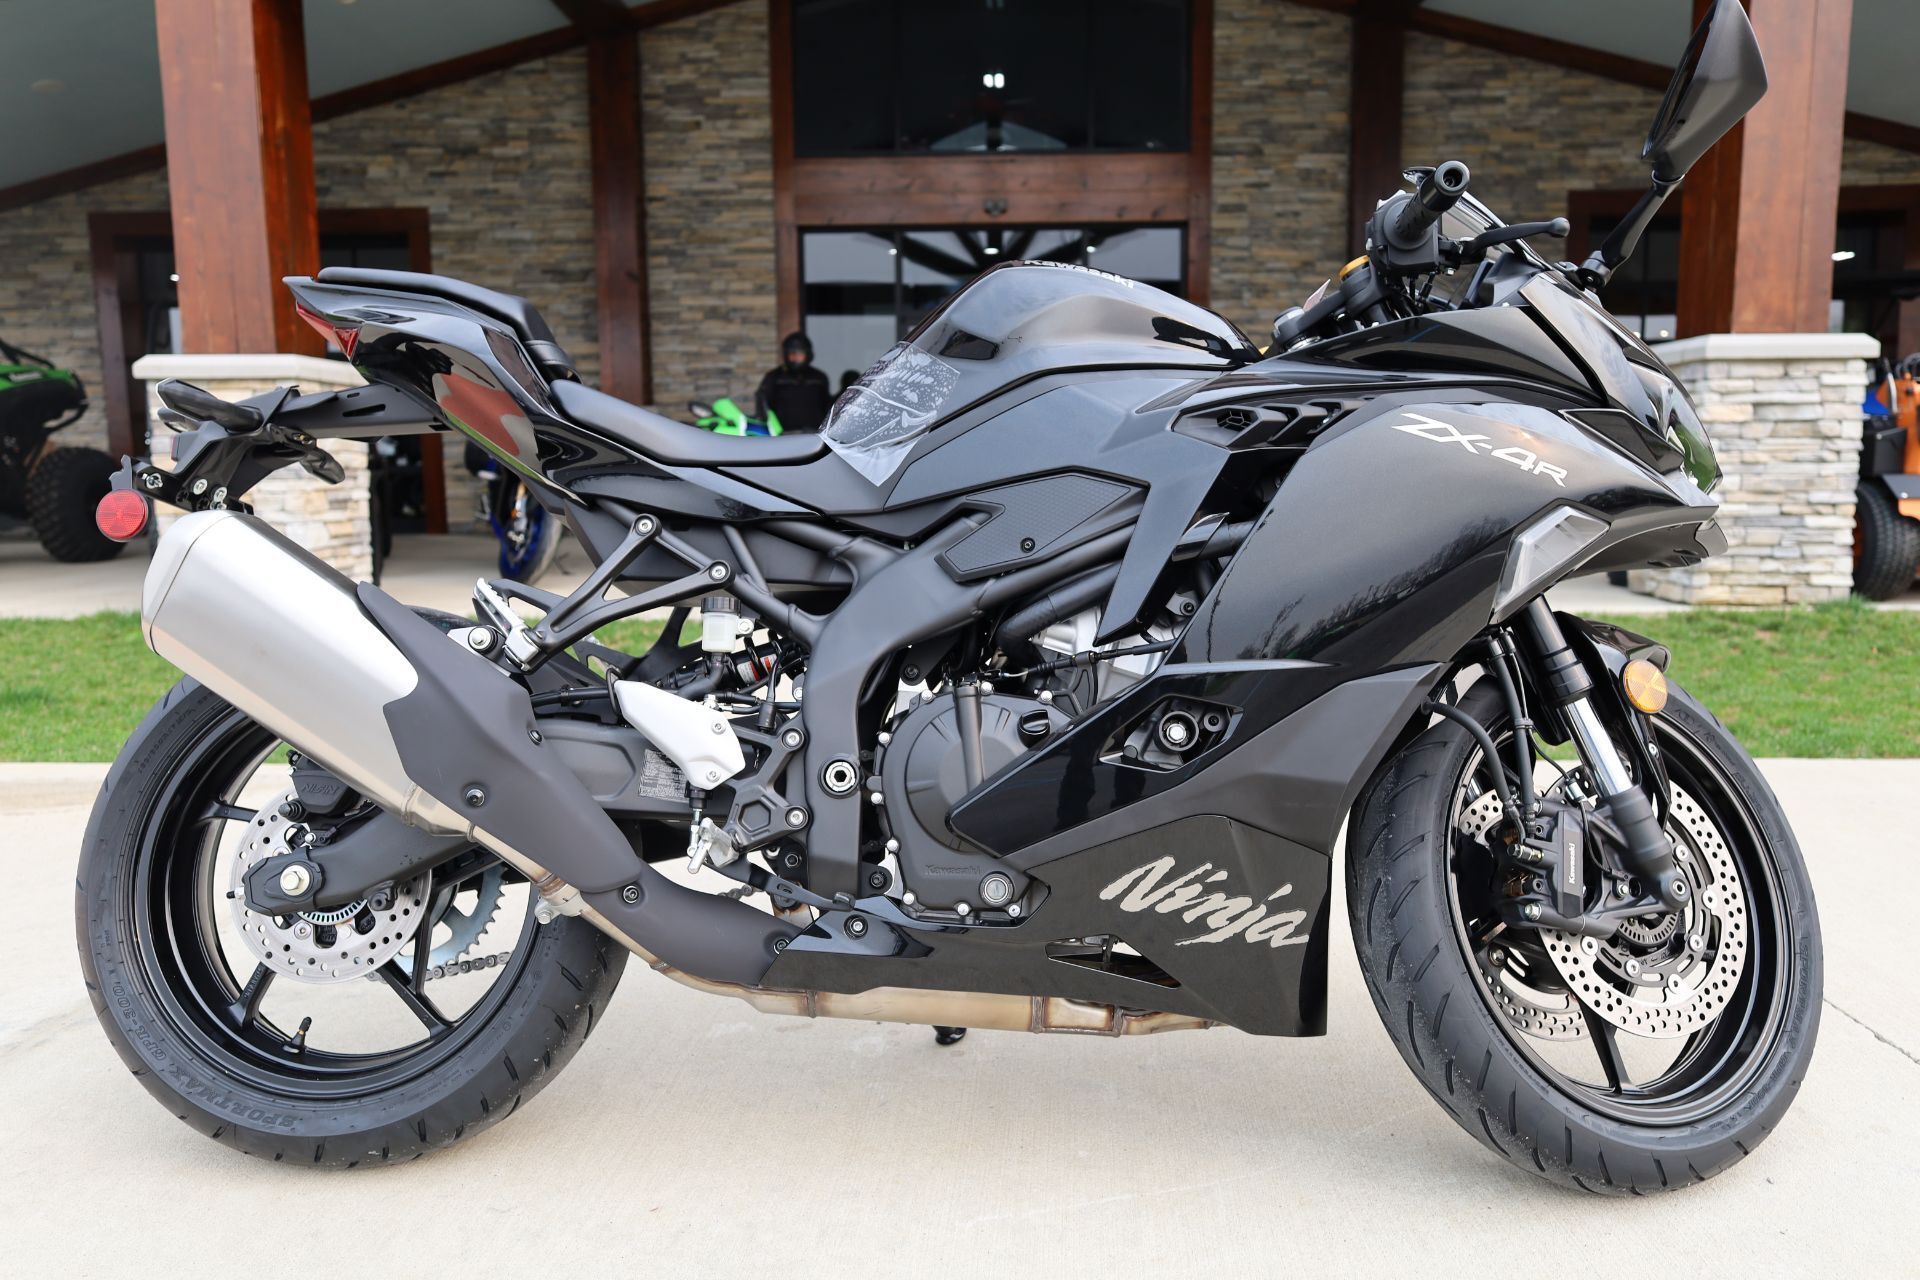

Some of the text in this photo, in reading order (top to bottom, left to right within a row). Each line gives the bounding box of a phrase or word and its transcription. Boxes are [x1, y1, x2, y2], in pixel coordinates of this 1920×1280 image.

[1392, 413, 1568, 487] ZX-4R
[1568, 842, 1576, 885] Kawasaki
[1100, 856, 1310, 948] Ninja
[169, 1064, 299, 1128] SPORTMAX
